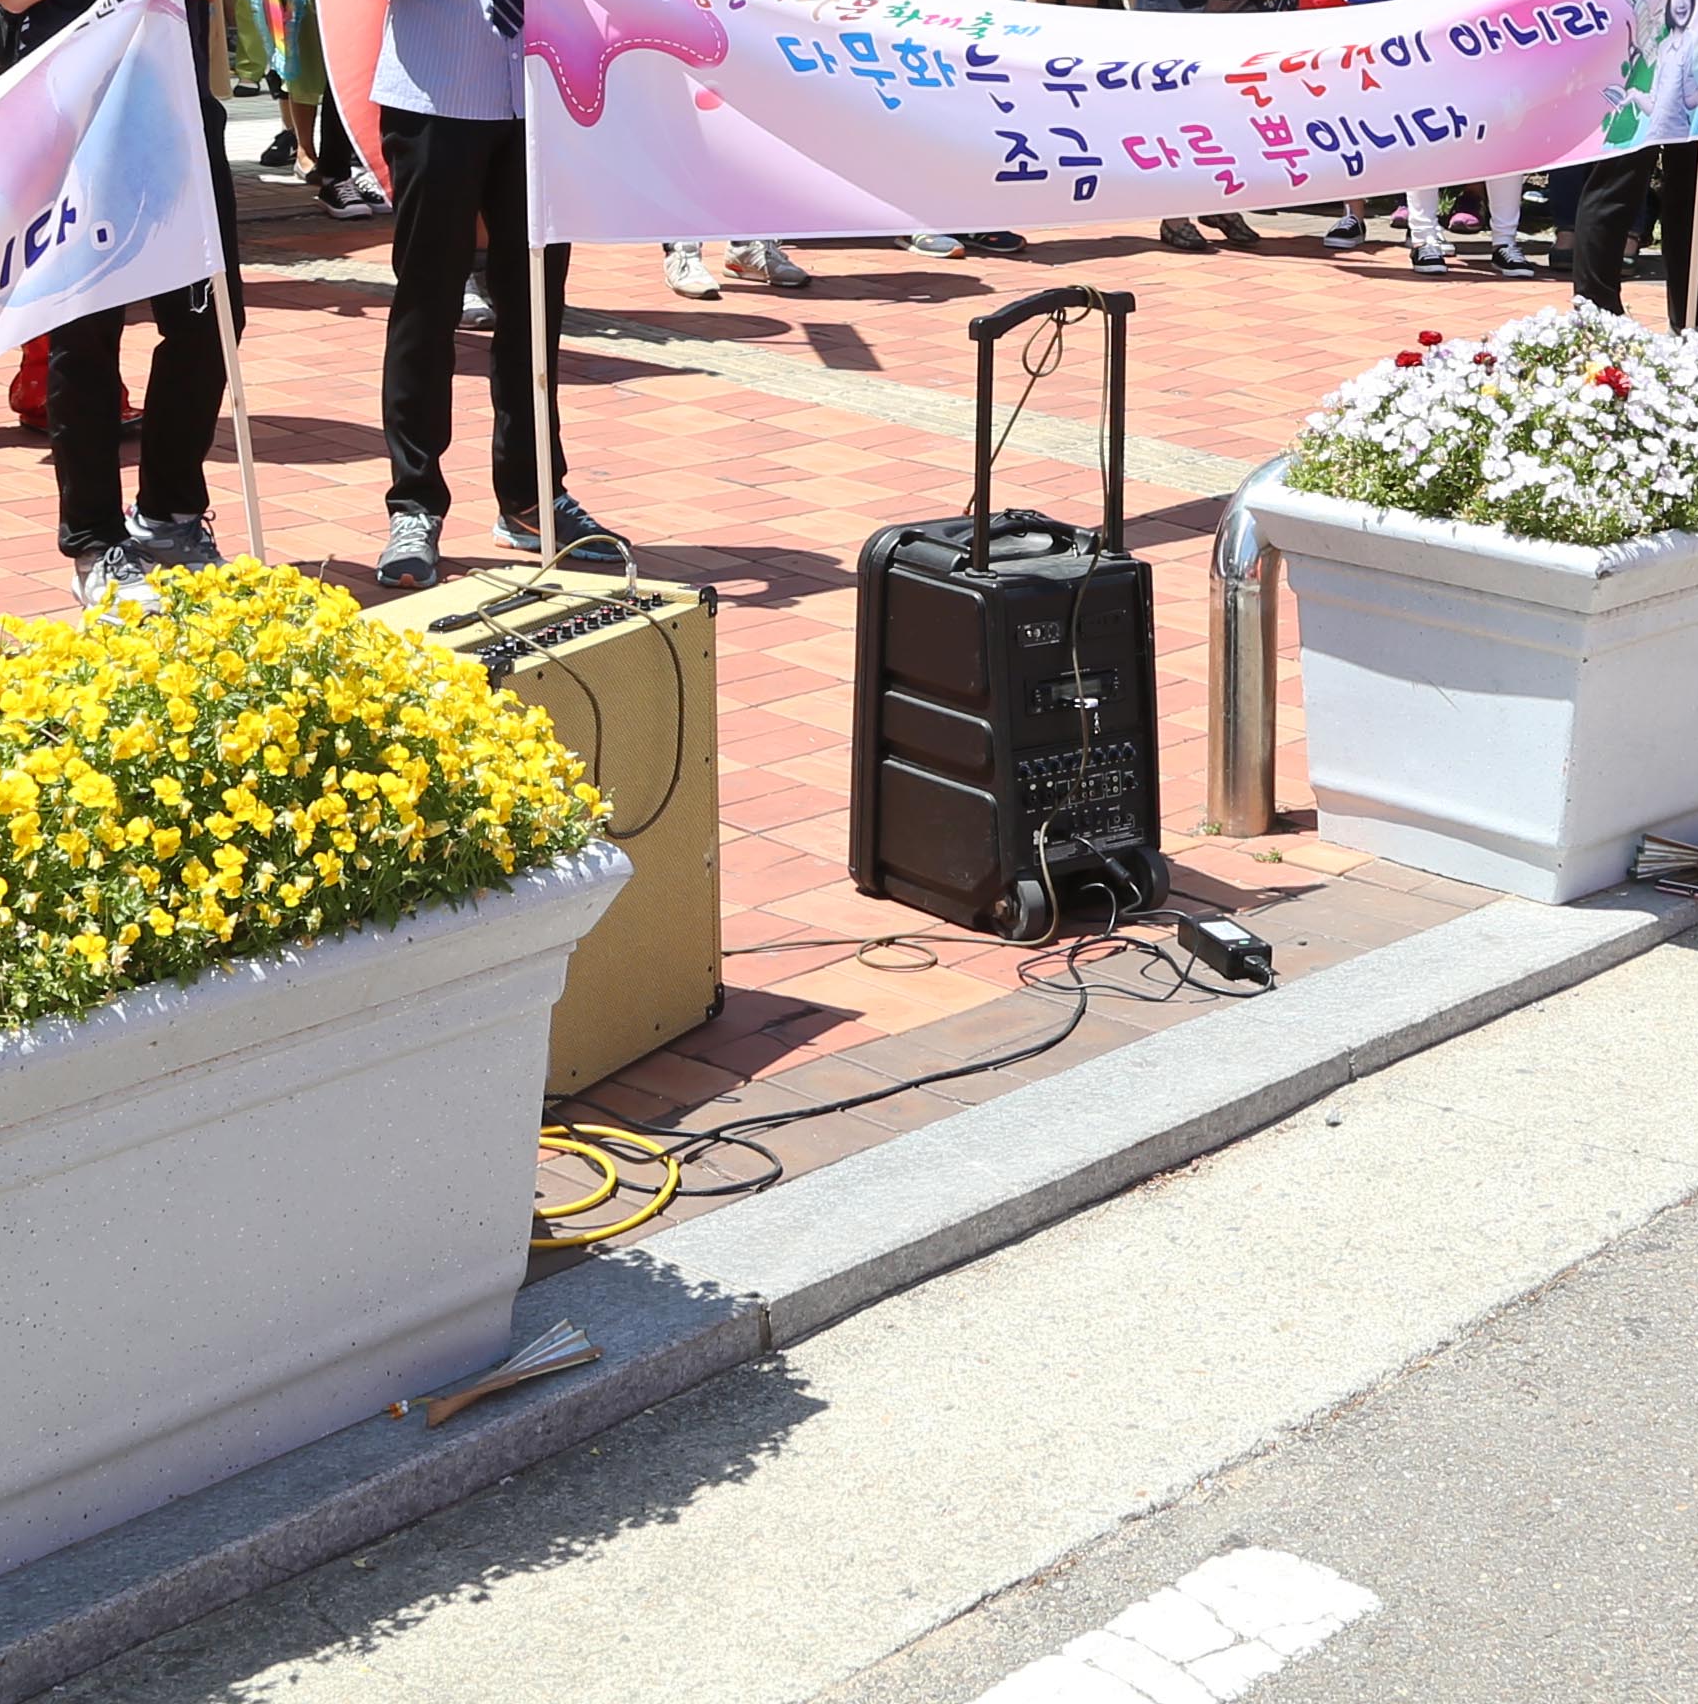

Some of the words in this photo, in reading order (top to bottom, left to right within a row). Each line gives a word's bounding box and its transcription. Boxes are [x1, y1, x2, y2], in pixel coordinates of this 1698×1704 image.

[776, 32, 1015, 113] 다문화는
[1042, 56, 1203, 108] 우리와
[1449, 2, 1609, 57] 아니라
[994, 126, 1103, 201] 조금
[1121, 123, 1246, 196] 다를
